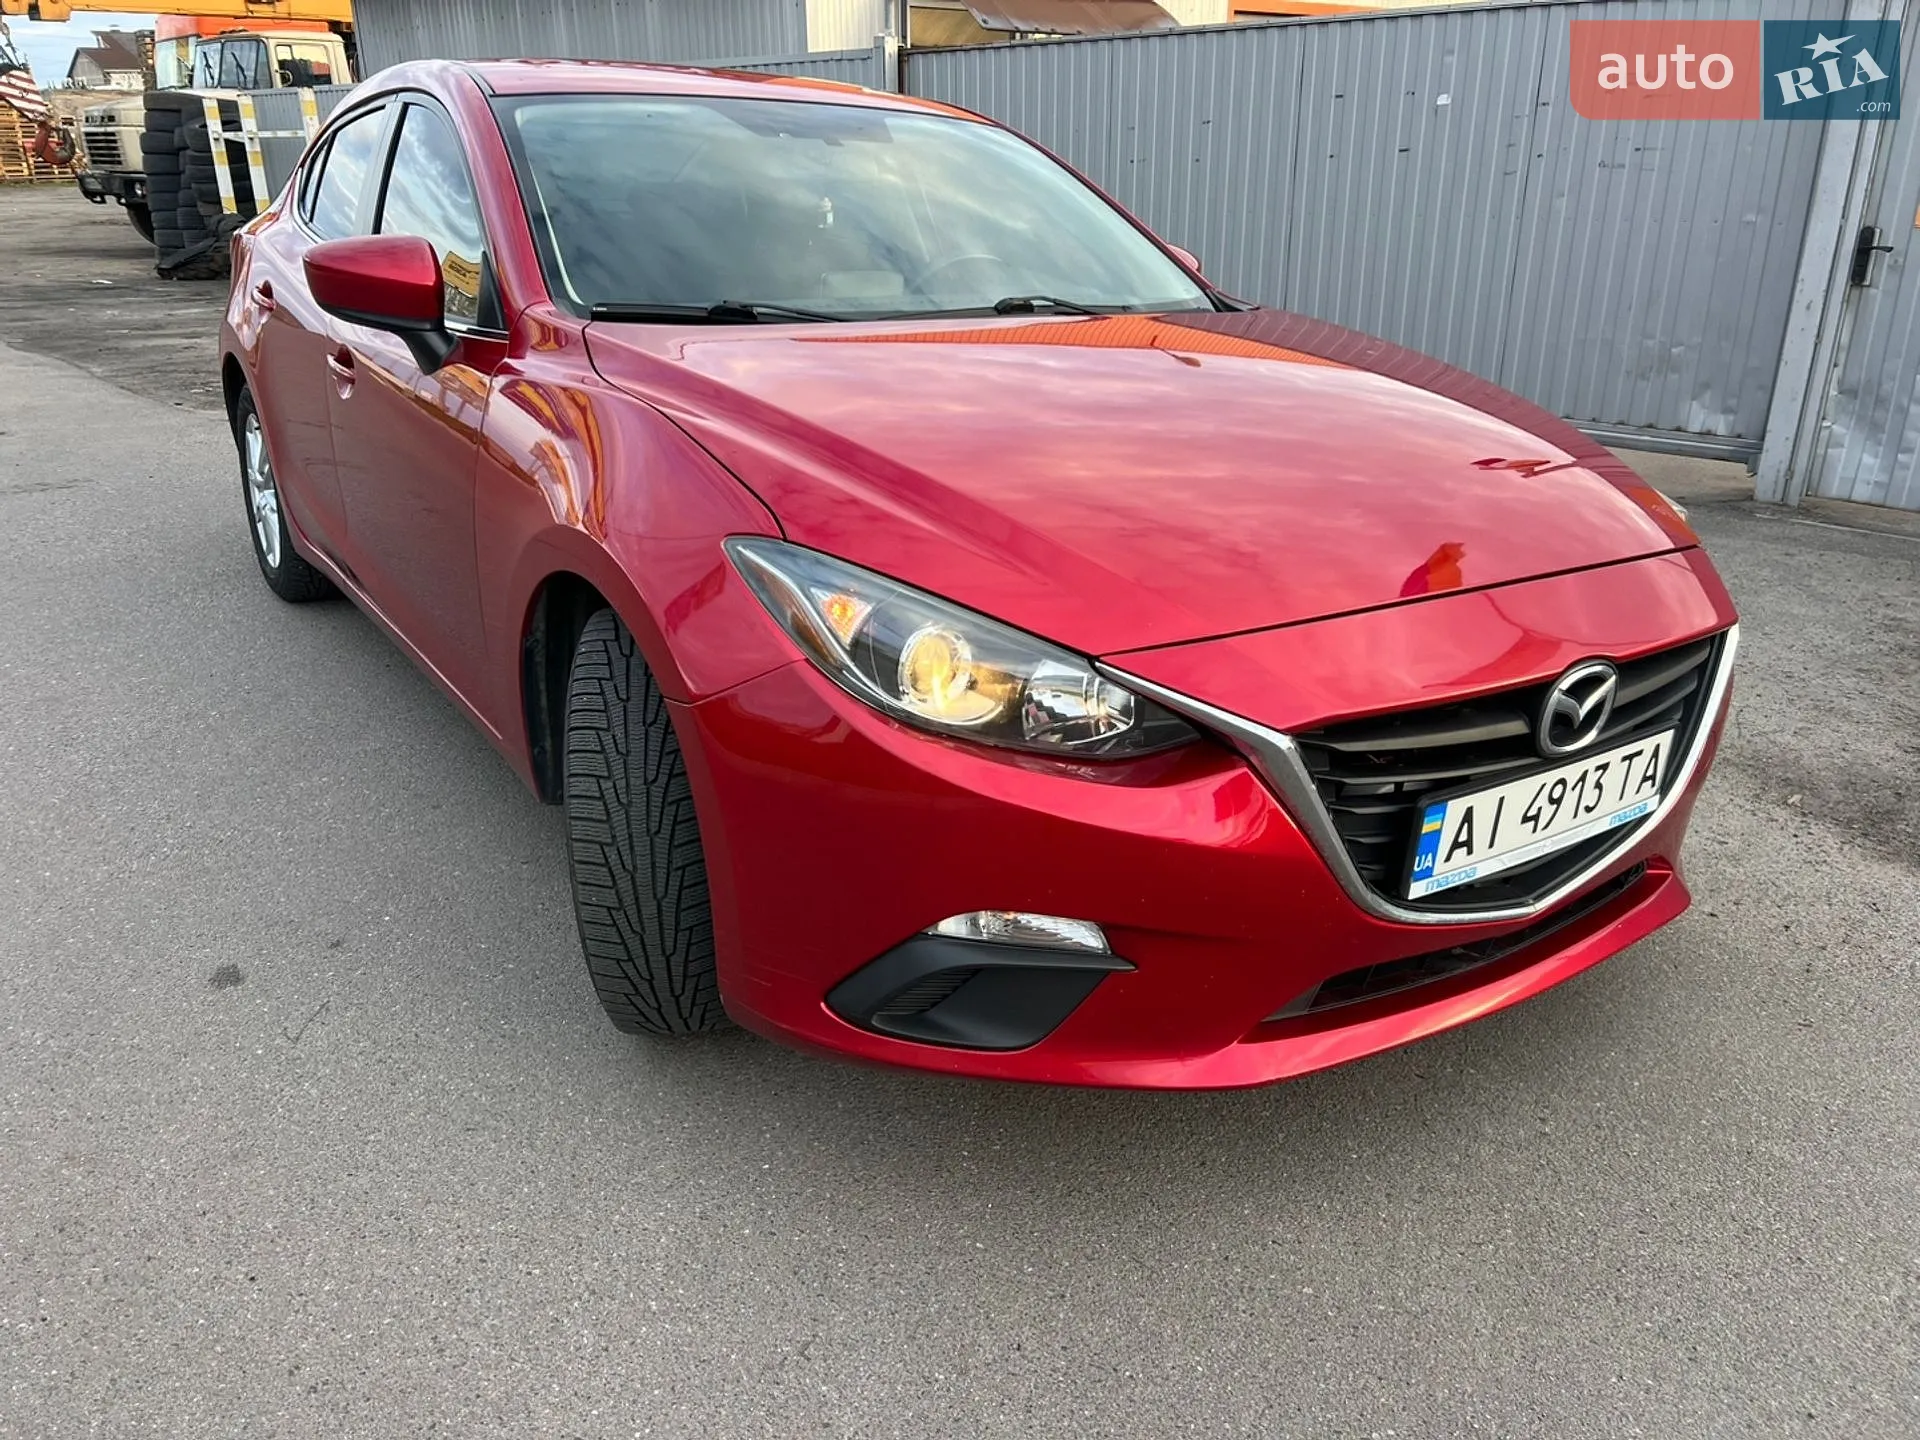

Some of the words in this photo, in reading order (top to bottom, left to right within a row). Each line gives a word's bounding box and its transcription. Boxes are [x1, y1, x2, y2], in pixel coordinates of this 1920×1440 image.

[1444, 797, 1505, 863] AI
[1520, 762, 1611, 834] 4913
[1619, 744, 1661, 801] TA
[1609, 803, 1648, 826] mazda
[1414, 853, 1433, 871] UA
[1425, 867, 1477, 892] mazda
